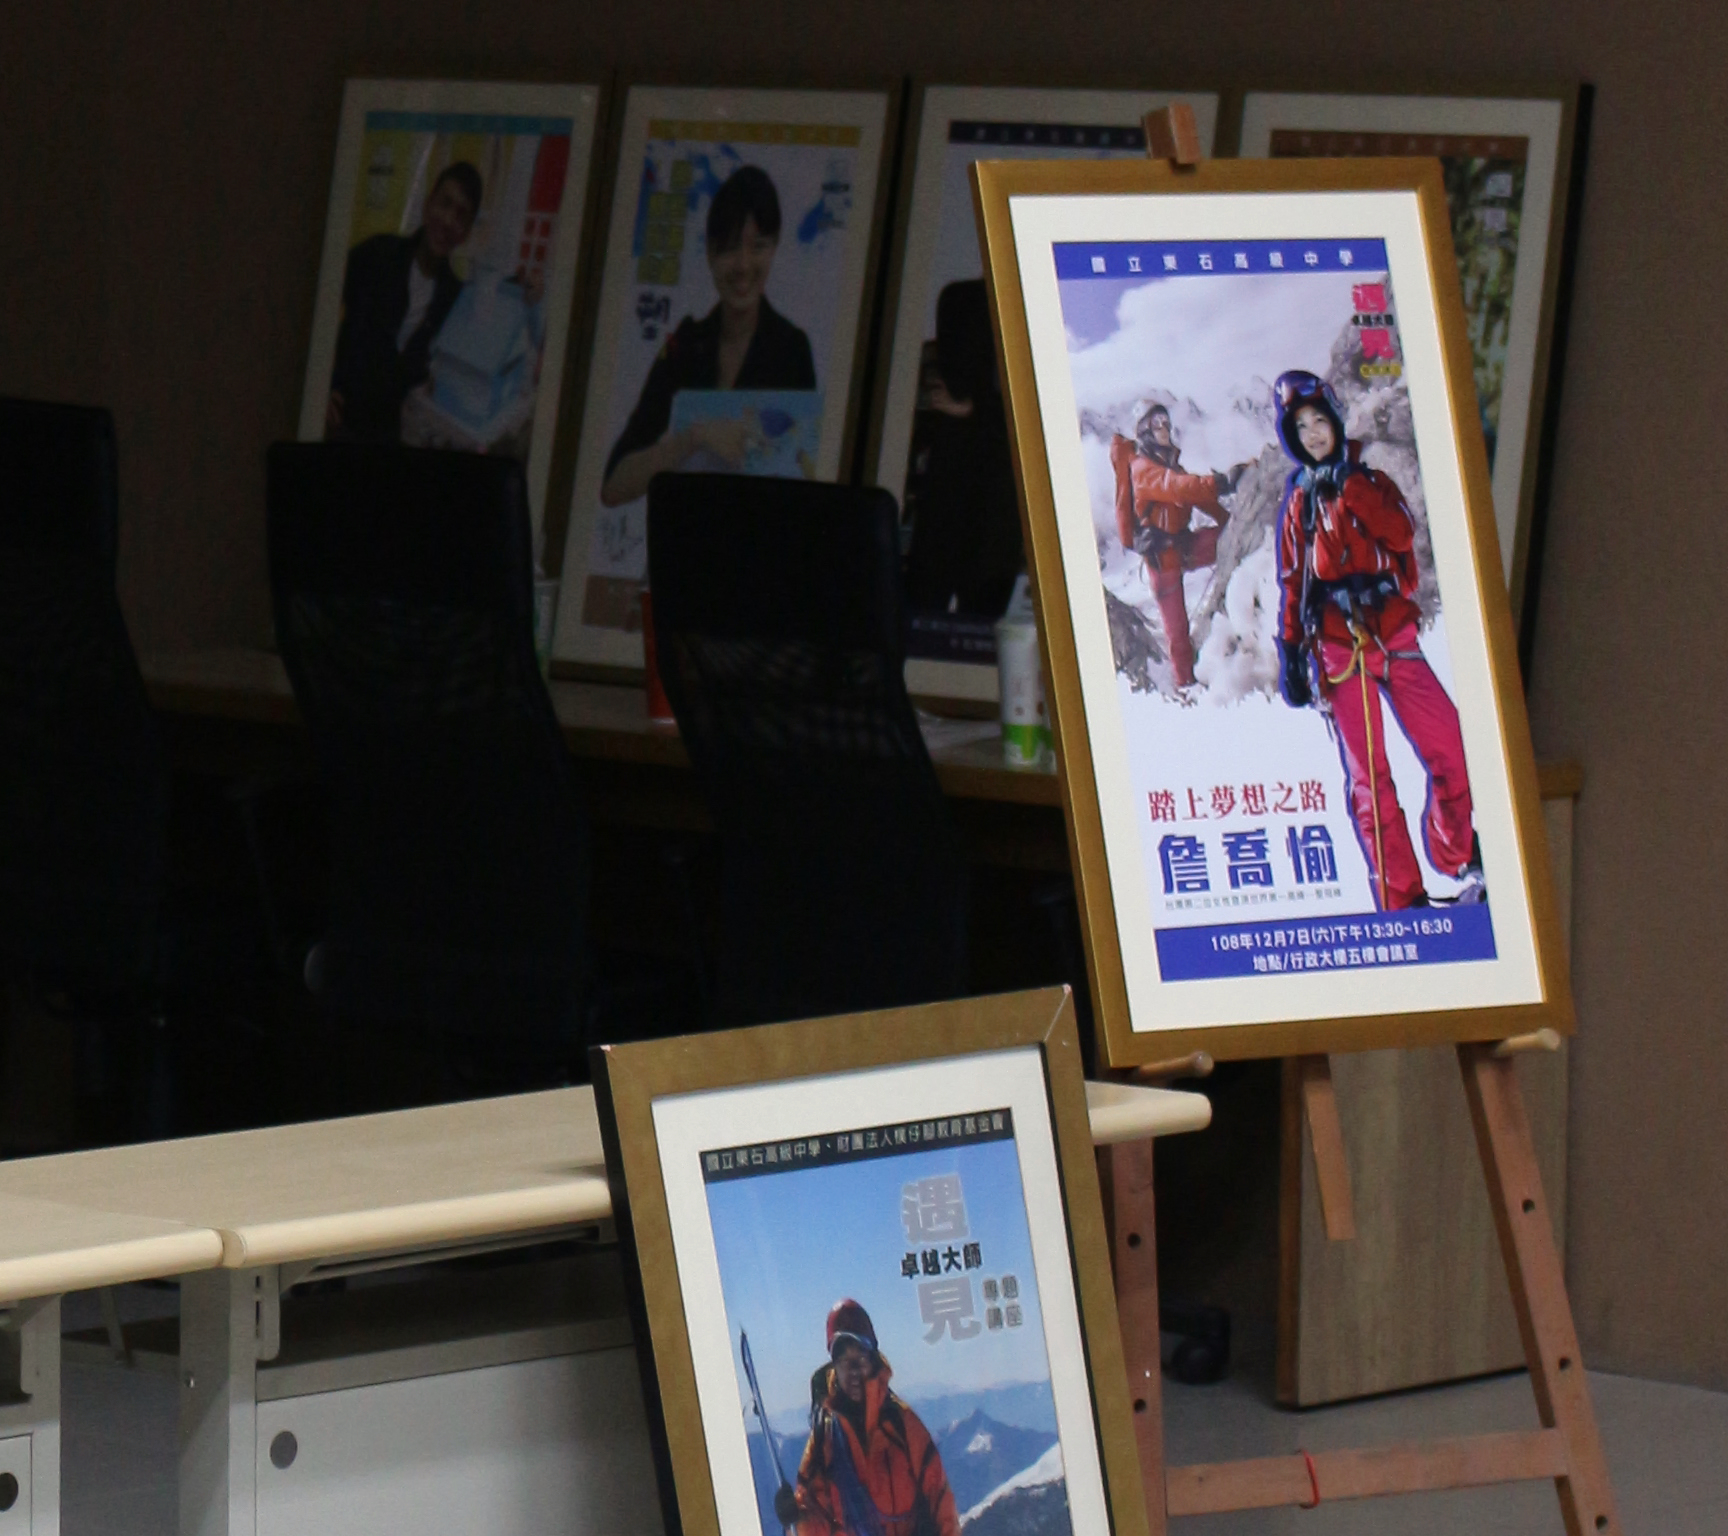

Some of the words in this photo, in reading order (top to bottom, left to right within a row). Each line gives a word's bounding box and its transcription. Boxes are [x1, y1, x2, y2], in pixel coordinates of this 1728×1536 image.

[1148, 779, 1326, 822] 踏上夢想之路
[1158, 825, 1338, 894] 詹喬愉
[1253, 944, 1419, 972] 地點/行政大樓五樓會議室
[901, 1173, 970, 1244] 遇
[901, 1241, 983, 1279] 卓越大師
[918, 1277, 981, 1344] 見
